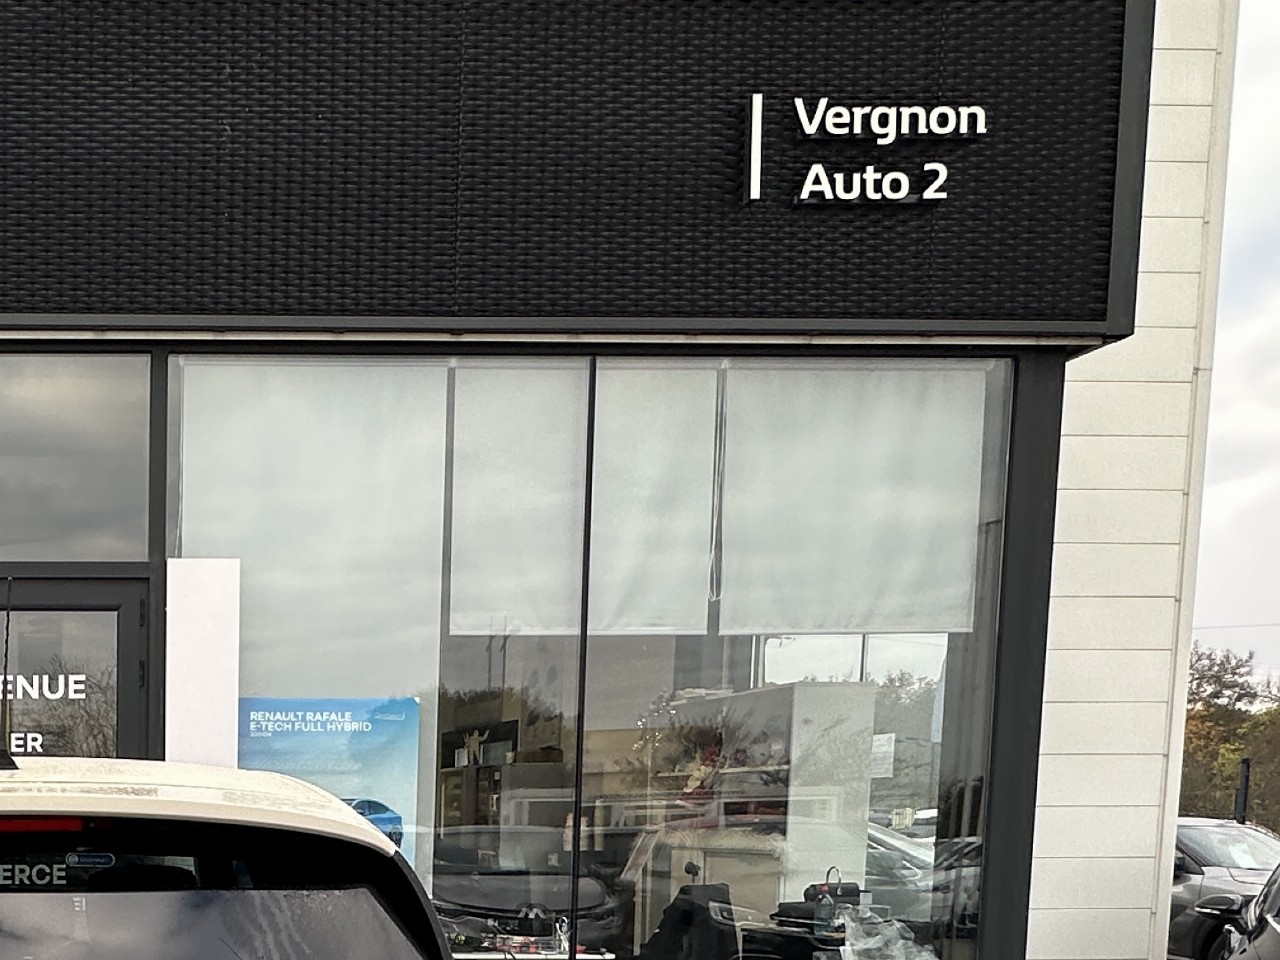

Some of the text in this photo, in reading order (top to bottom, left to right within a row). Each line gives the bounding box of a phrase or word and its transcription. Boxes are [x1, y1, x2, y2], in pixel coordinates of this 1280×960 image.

[793, 97, 988, 146] Vergnon
[799, 162, 949, 201] Auto 2
[249, 711, 352, 722] RENAULT RAFALE
[249, 721, 372, 732] E-TECH FULL HYBRID
